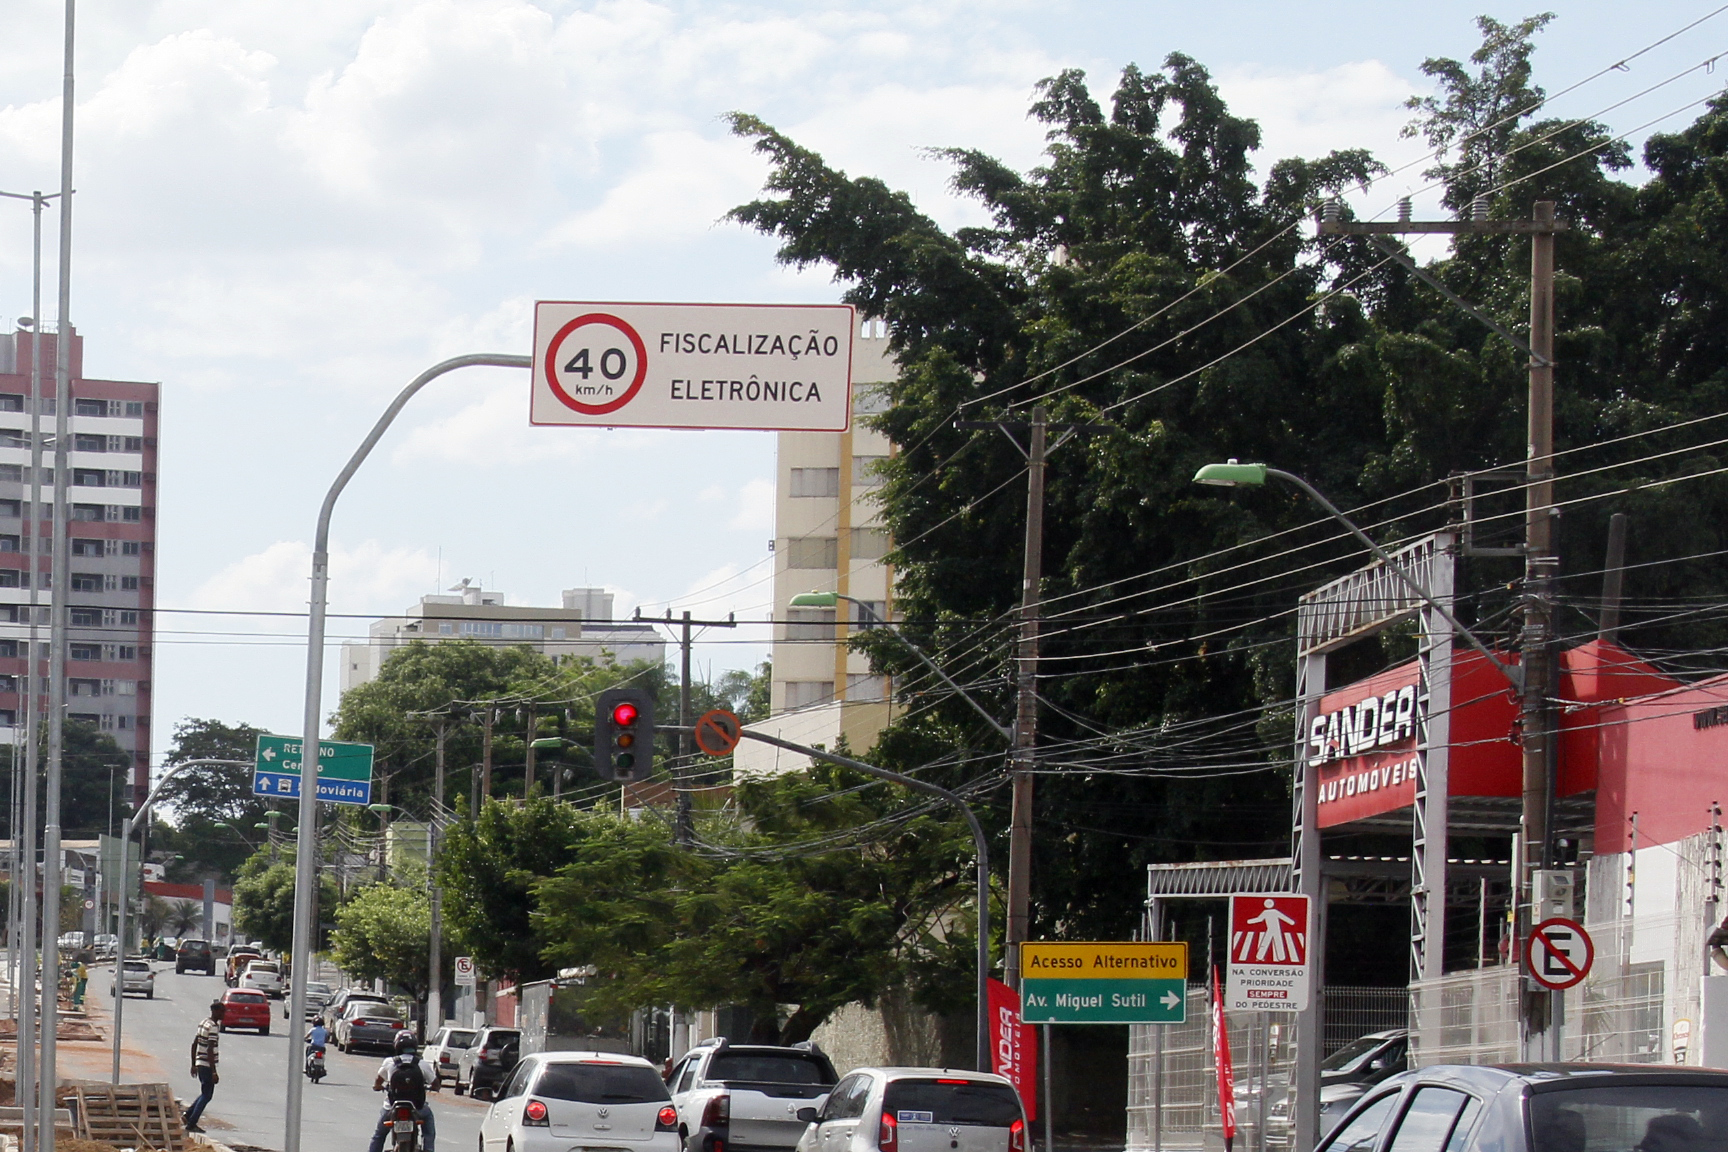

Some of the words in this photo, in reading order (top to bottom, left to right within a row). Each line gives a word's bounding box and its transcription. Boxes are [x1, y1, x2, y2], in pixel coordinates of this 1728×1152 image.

[659, 329, 839, 361] FISCALIZAÇÃO
[563, 347, 627, 380] 40
[575, 383, 613, 396] km/h
[670, 374, 822, 402] ELETRÔNICA
[1308, 684, 1415, 768] SANDER
[283, 743, 335, 758] RETNO
[1317, 757, 1417, 805] AUTOMÓVEIS
[1030, 955, 1083, 969] Acesso
[1093, 954, 1178, 969] Alternativo
[1240, 979, 1294, 987] PRIORIDADE
[1026, 993, 1048, 1008] Av.
[1055, 993, 1103, 1012] Miguel
[1111, 993, 1147, 1008] Sutil
[1249, 990, 1286, 998] SEMPRE
[1235, 1001, 1248, 1009] DO
[998, 1006, 1013, 1081] NDER
